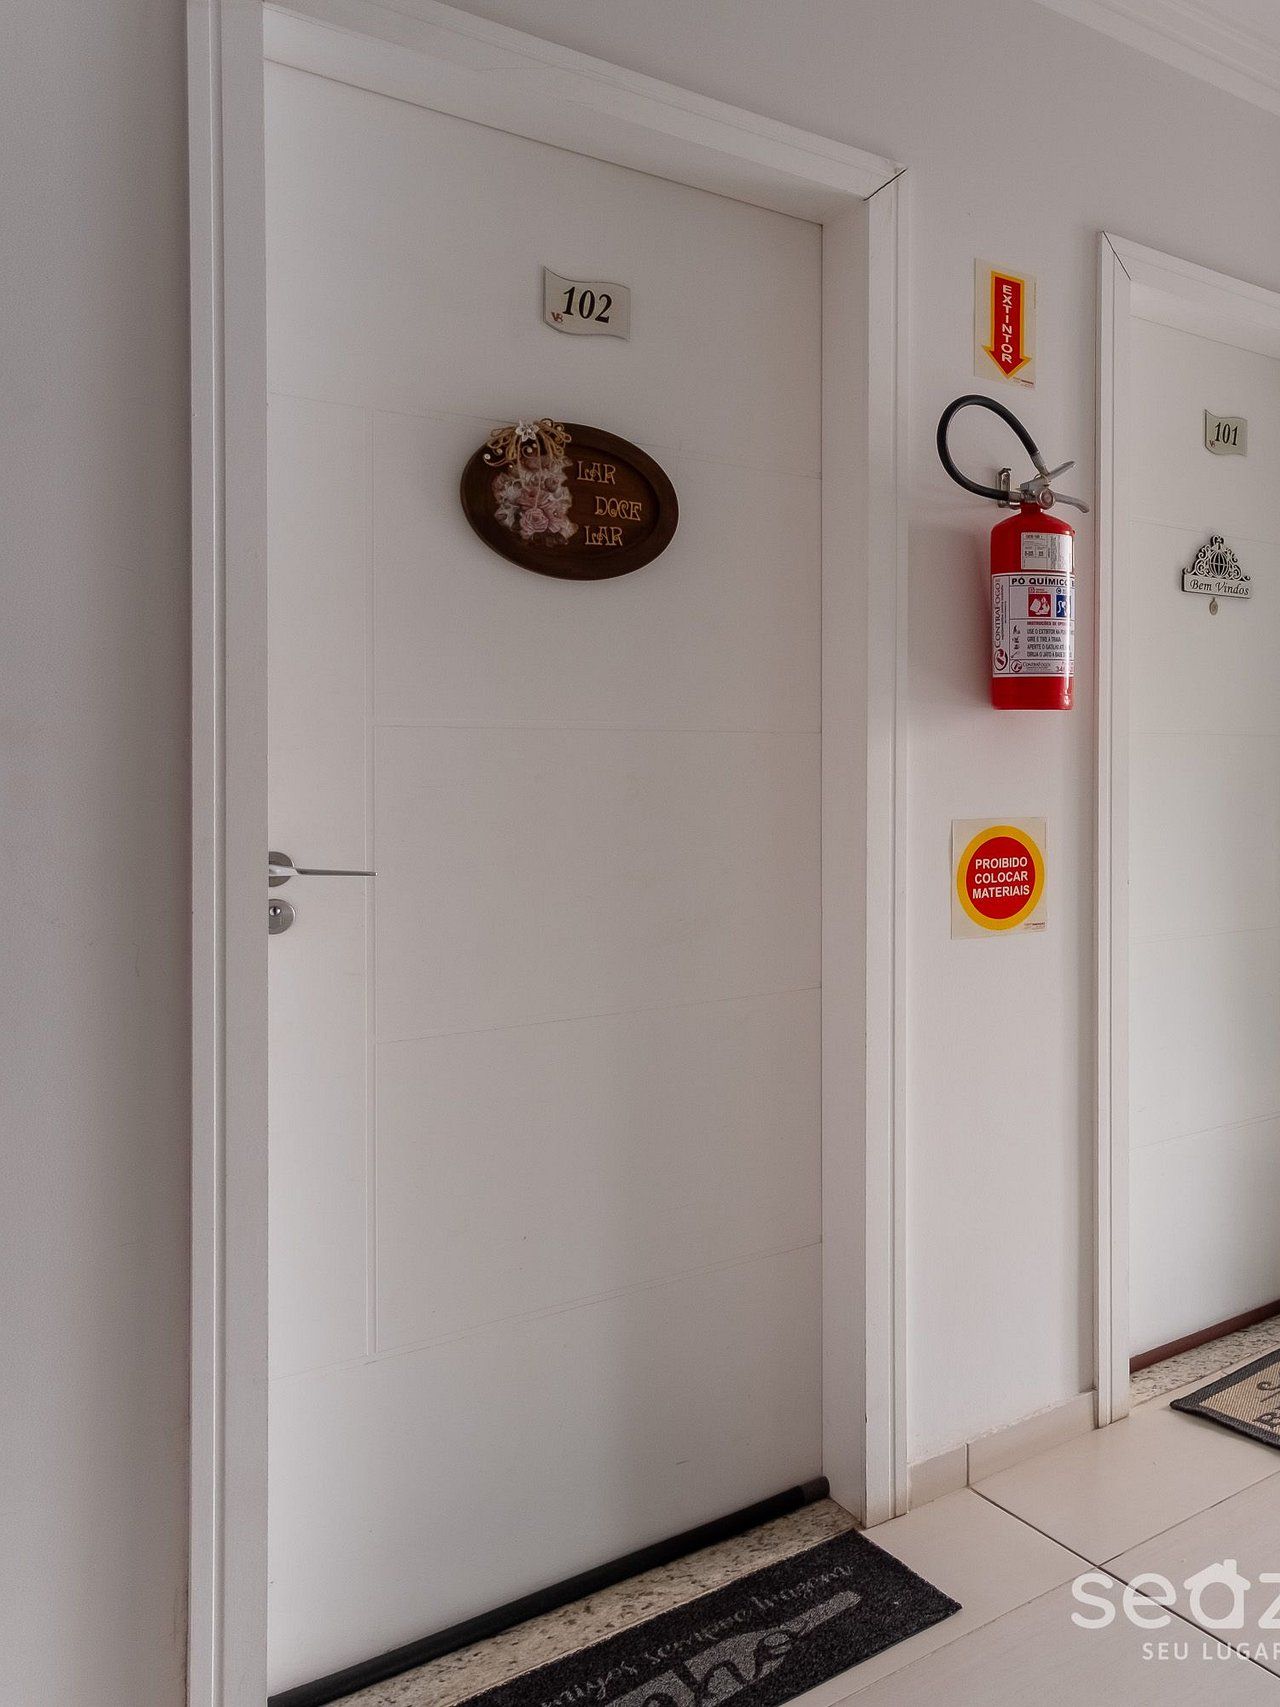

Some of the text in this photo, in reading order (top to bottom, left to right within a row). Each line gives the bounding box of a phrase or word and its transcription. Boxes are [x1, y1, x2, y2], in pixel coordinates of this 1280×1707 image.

[562, 286, 613, 324] 102
[1001, 284, 1013, 364] EXTINTOR
[1214, 422, 1239, 446] 101
[576, 461, 617, 485] LAR
[594, 496, 642, 521] DOCE
[583, 525, 623, 546] LAR
[1011, 577, 1026, 585] PÓ
[1190, 579, 1250, 596] Bem Vindos
[975, 857, 1028, 870] PROIBIDO
[974, 870, 1028, 884] COLOCAR
[972, 884, 1030, 899] MATERIAIS
